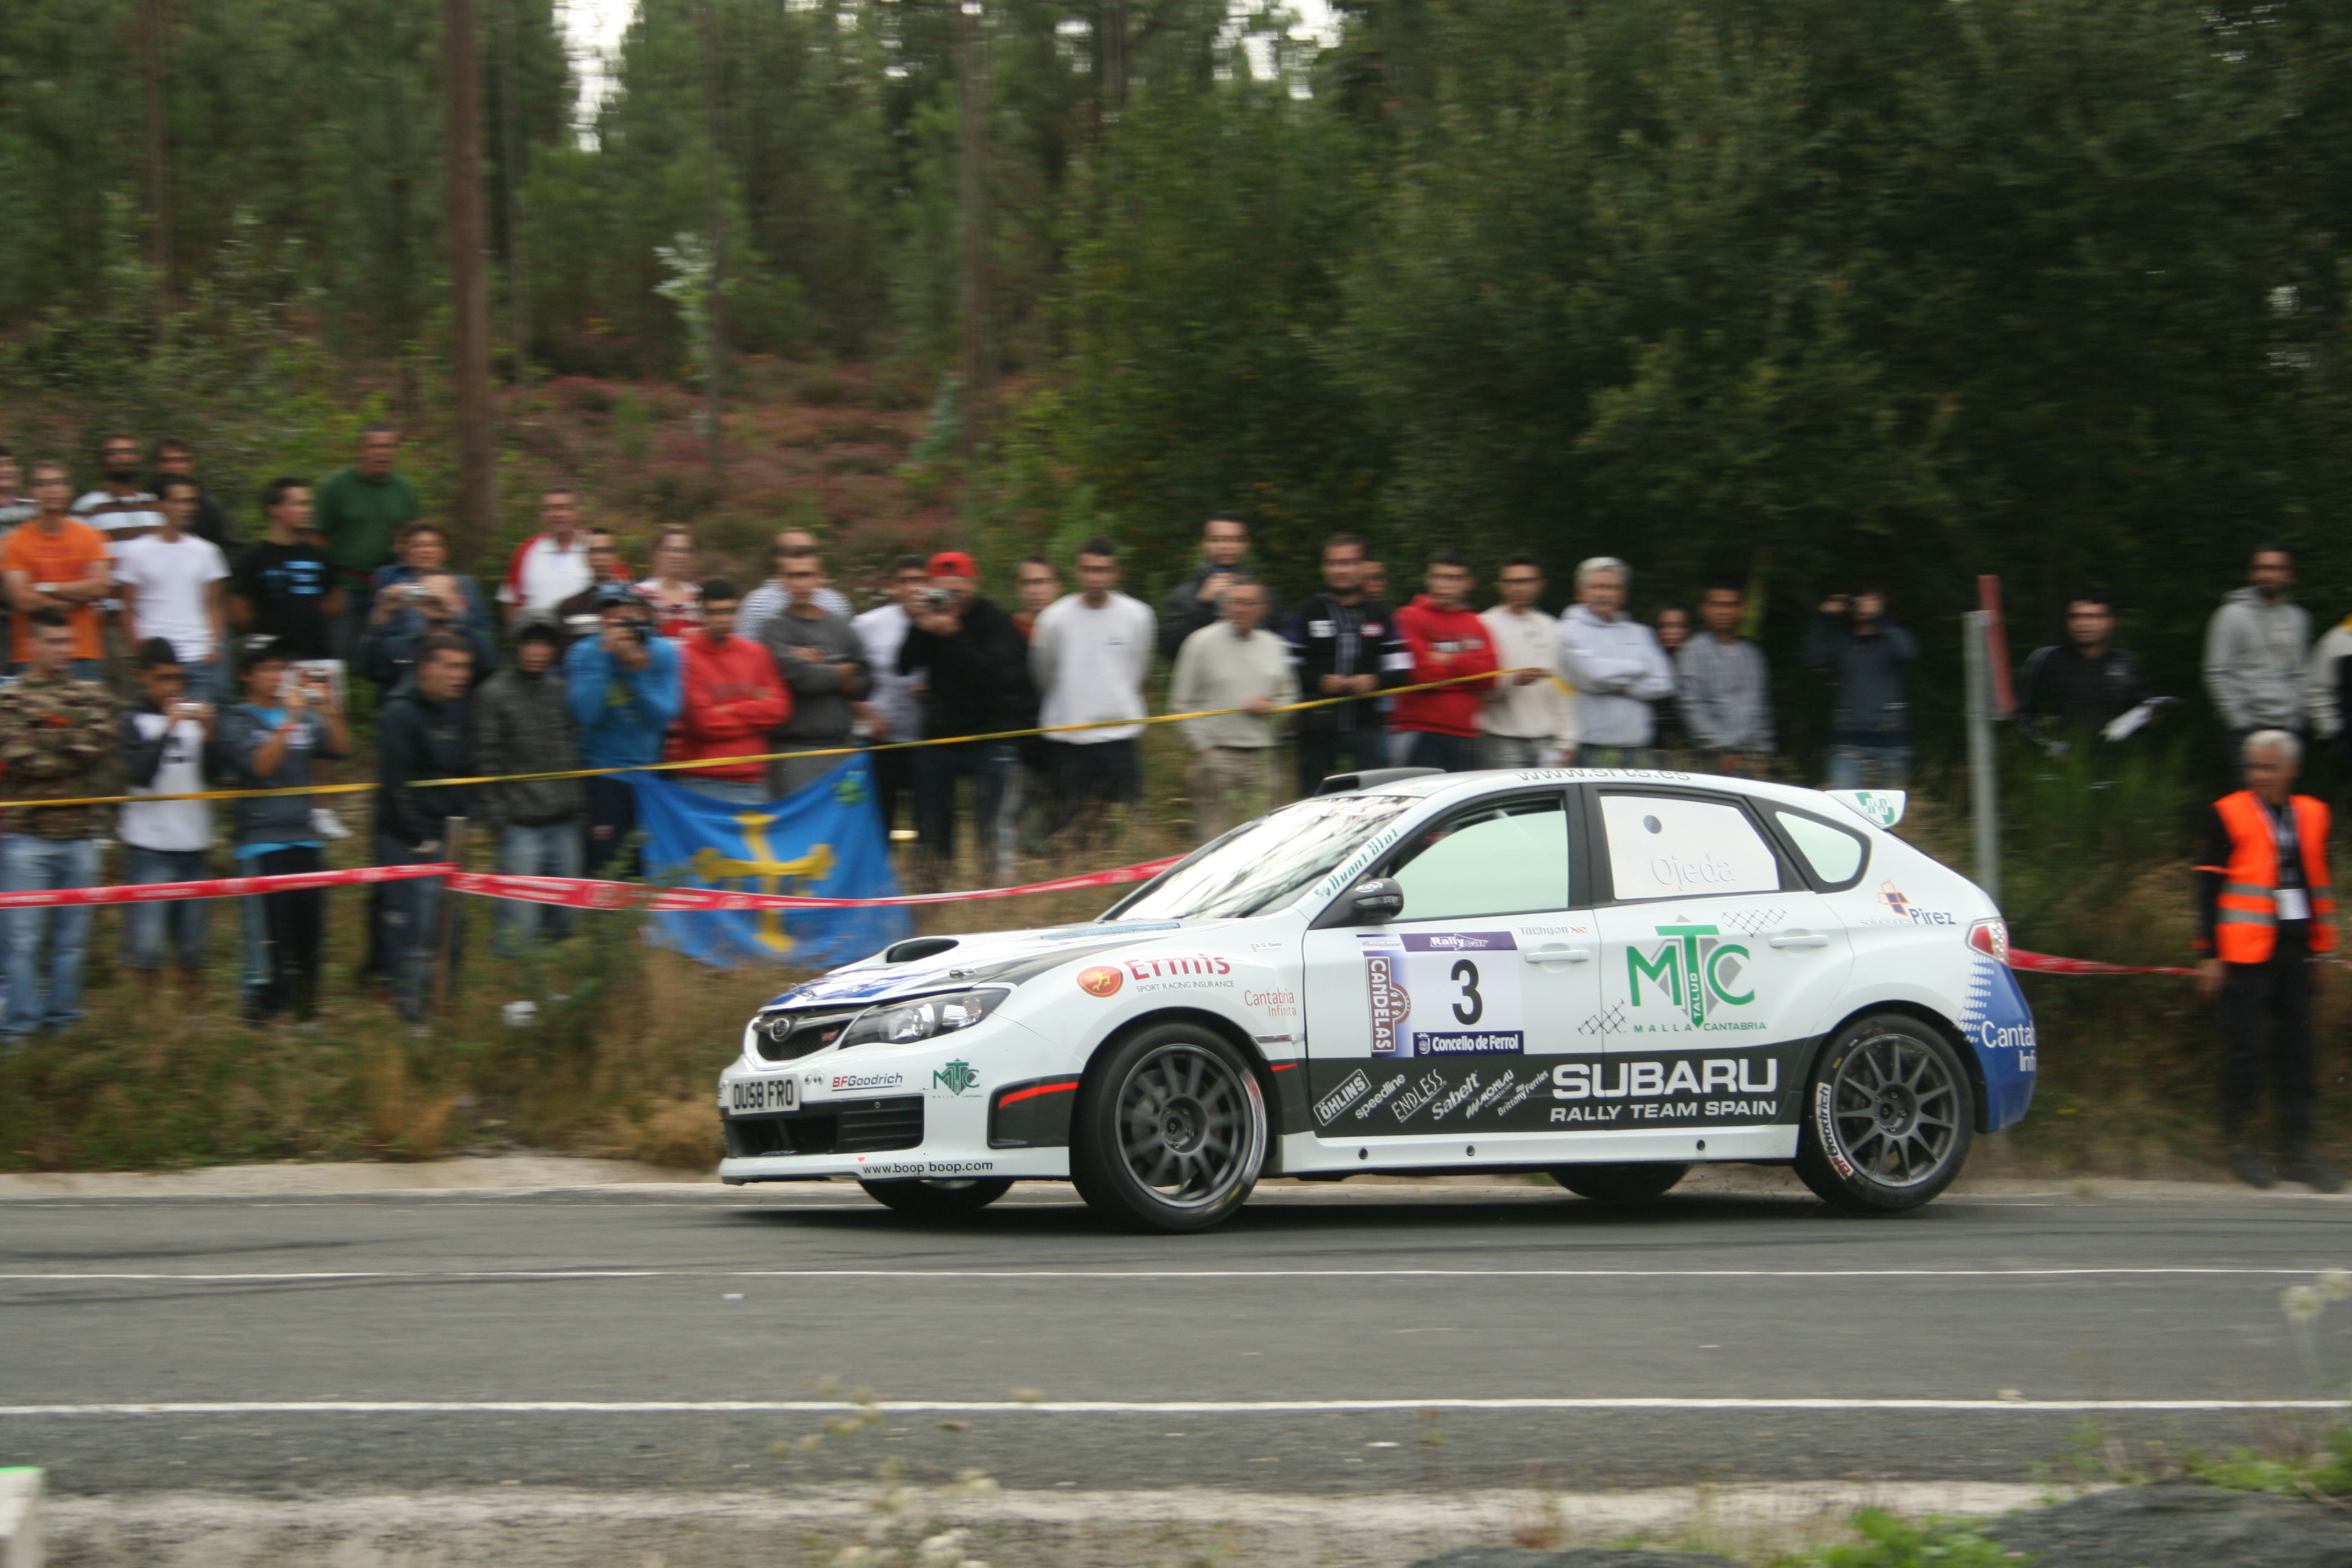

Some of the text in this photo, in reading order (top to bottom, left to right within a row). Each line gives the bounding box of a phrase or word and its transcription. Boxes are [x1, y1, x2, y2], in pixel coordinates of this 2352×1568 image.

[1651, 853, 1737, 891] Ojeda
[1908, 908, 1956, 925] Pirez
[1123, 952, 1232, 981] Ermis
[1136, 980, 1235, 993] SPORT RACING INSURANCE
[1244, 989, 1295, 1007] Cantabria
[1451, 959, 1483, 1025] 3
[1690, 972, 1702, 1019] TALUD
[1268, 1005, 1296, 1018] Infinita
[1370, 959, 1391, 1049] CANDELAS
[1432, 1033, 1519, 1051] Concello de Ferrol
[1634, 1022, 1766, 1033] MALLA CANTABRIA
[832, 1073, 903, 1088] BFGoodrich
[1552, 1058, 1777, 1100] SUBARU
[1318, 1076, 1366, 1120] ÖHLINS
[1354, 1074, 1406, 1119] speedline
[1391, 1068, 1445, 1120] ENDLESS
[1431, 1072, 1480, 1120] Sabelt
[1550, 1100, 1777, 1122] RALLY TEAM SPAIN
[863, 1161, 993, 1174] www.boop boop.com
